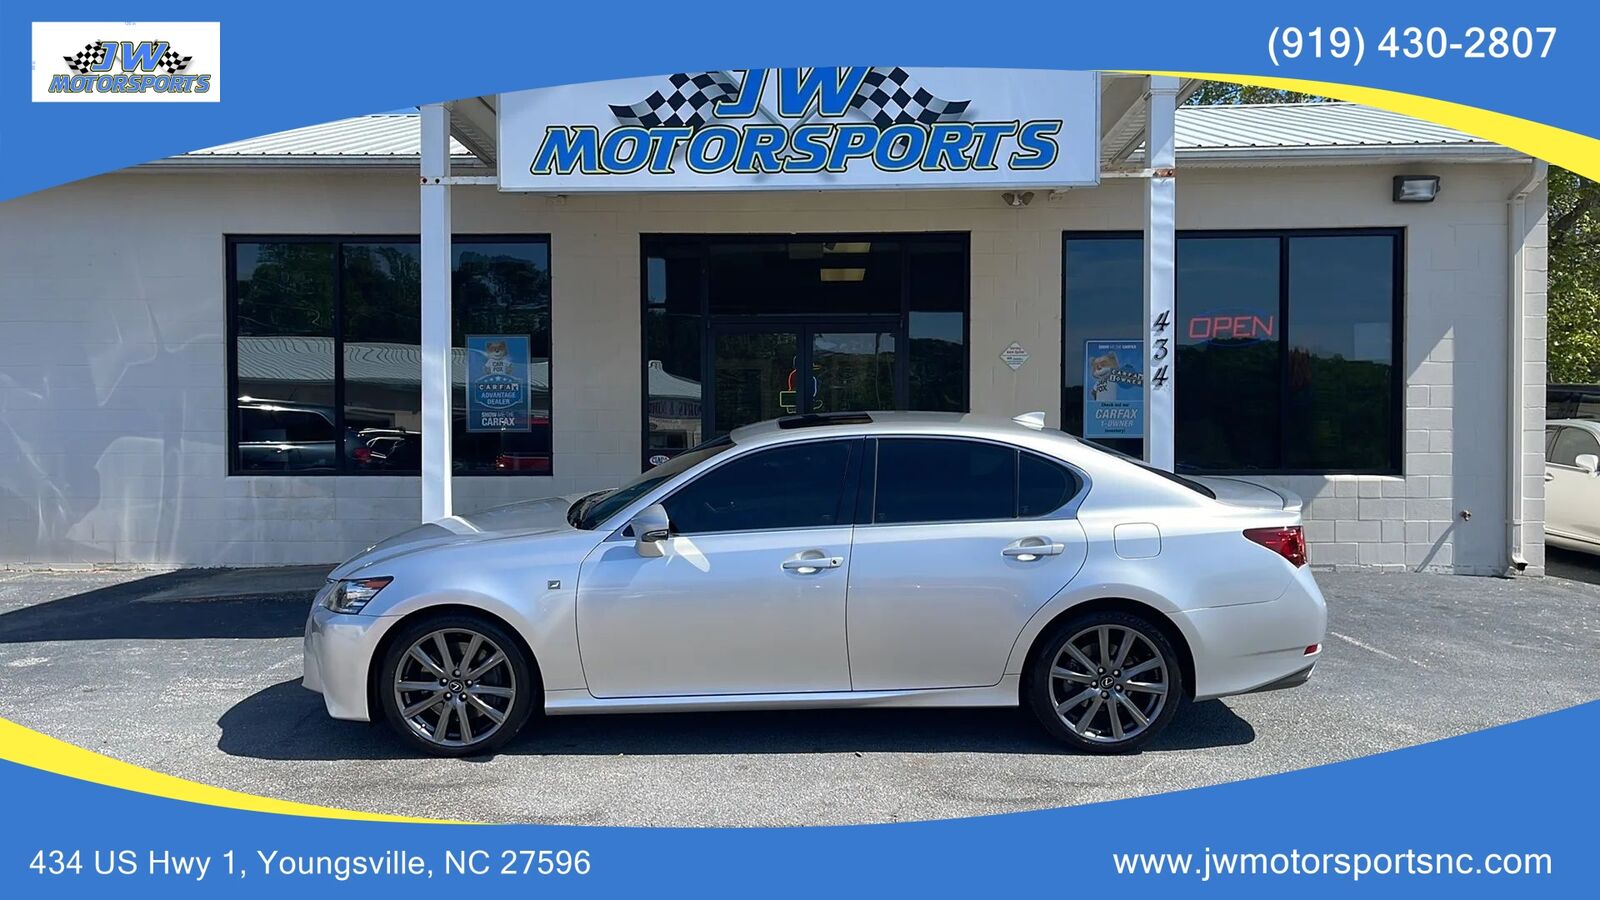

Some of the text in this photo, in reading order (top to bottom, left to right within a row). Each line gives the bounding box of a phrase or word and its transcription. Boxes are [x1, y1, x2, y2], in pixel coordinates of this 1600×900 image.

[713, 67, 873, 118] JW
[530, 118, 1063, 176] MOTORSPORTS
[1188, 315, 1274, 339] OPEN
[481, 417, 516, 426] CARFAX
[1095, 408, 1138, 419] CARFAX
